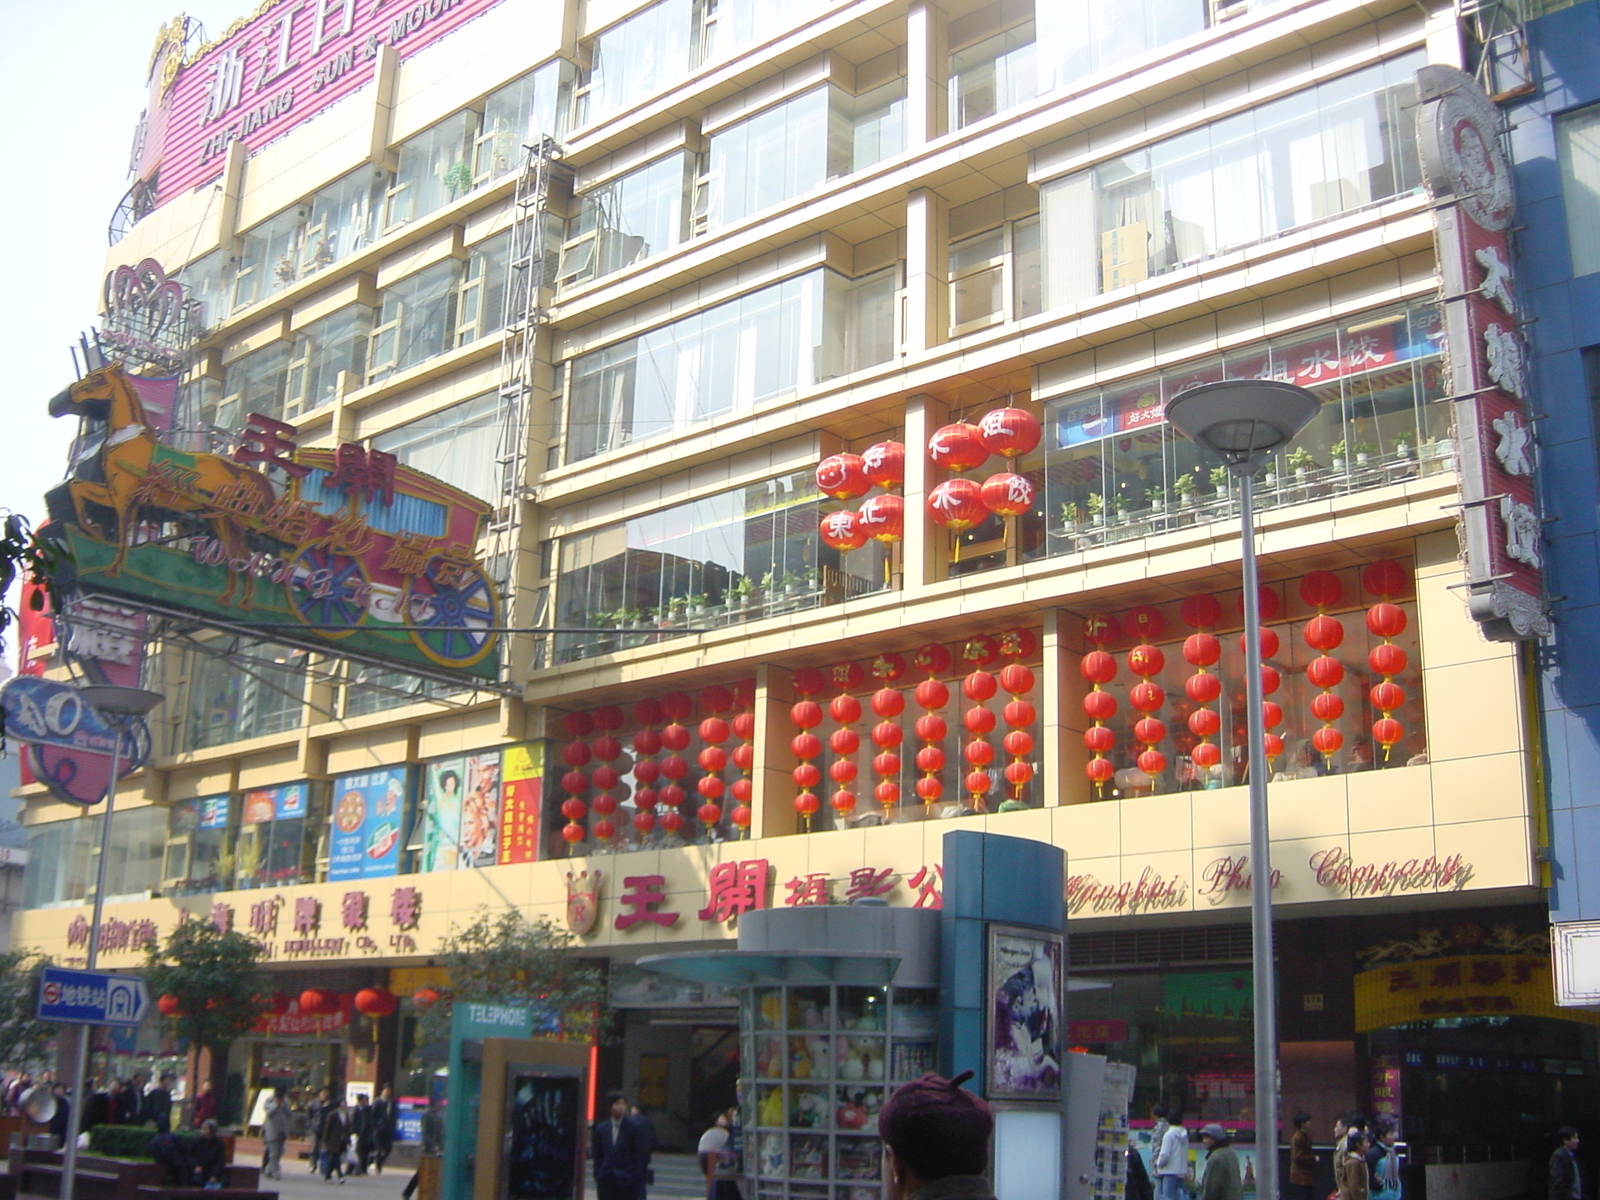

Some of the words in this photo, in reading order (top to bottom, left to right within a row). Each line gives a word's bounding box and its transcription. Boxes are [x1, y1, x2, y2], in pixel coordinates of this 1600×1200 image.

[200, 0, 392, 127] 浙江日
[200, 88, 295, 165] ZHEJIANG
[311, 46, 355, 93] SUN
[361, 34, 379, 60] &
[828, 514, 854, 539] 東
[859, 498, 887, 525] 北
[932, 482, 962, 510] 水
[1309, 847, 1460, 894] Company
[468, 1004, 527, 1027] TELEPHONE
